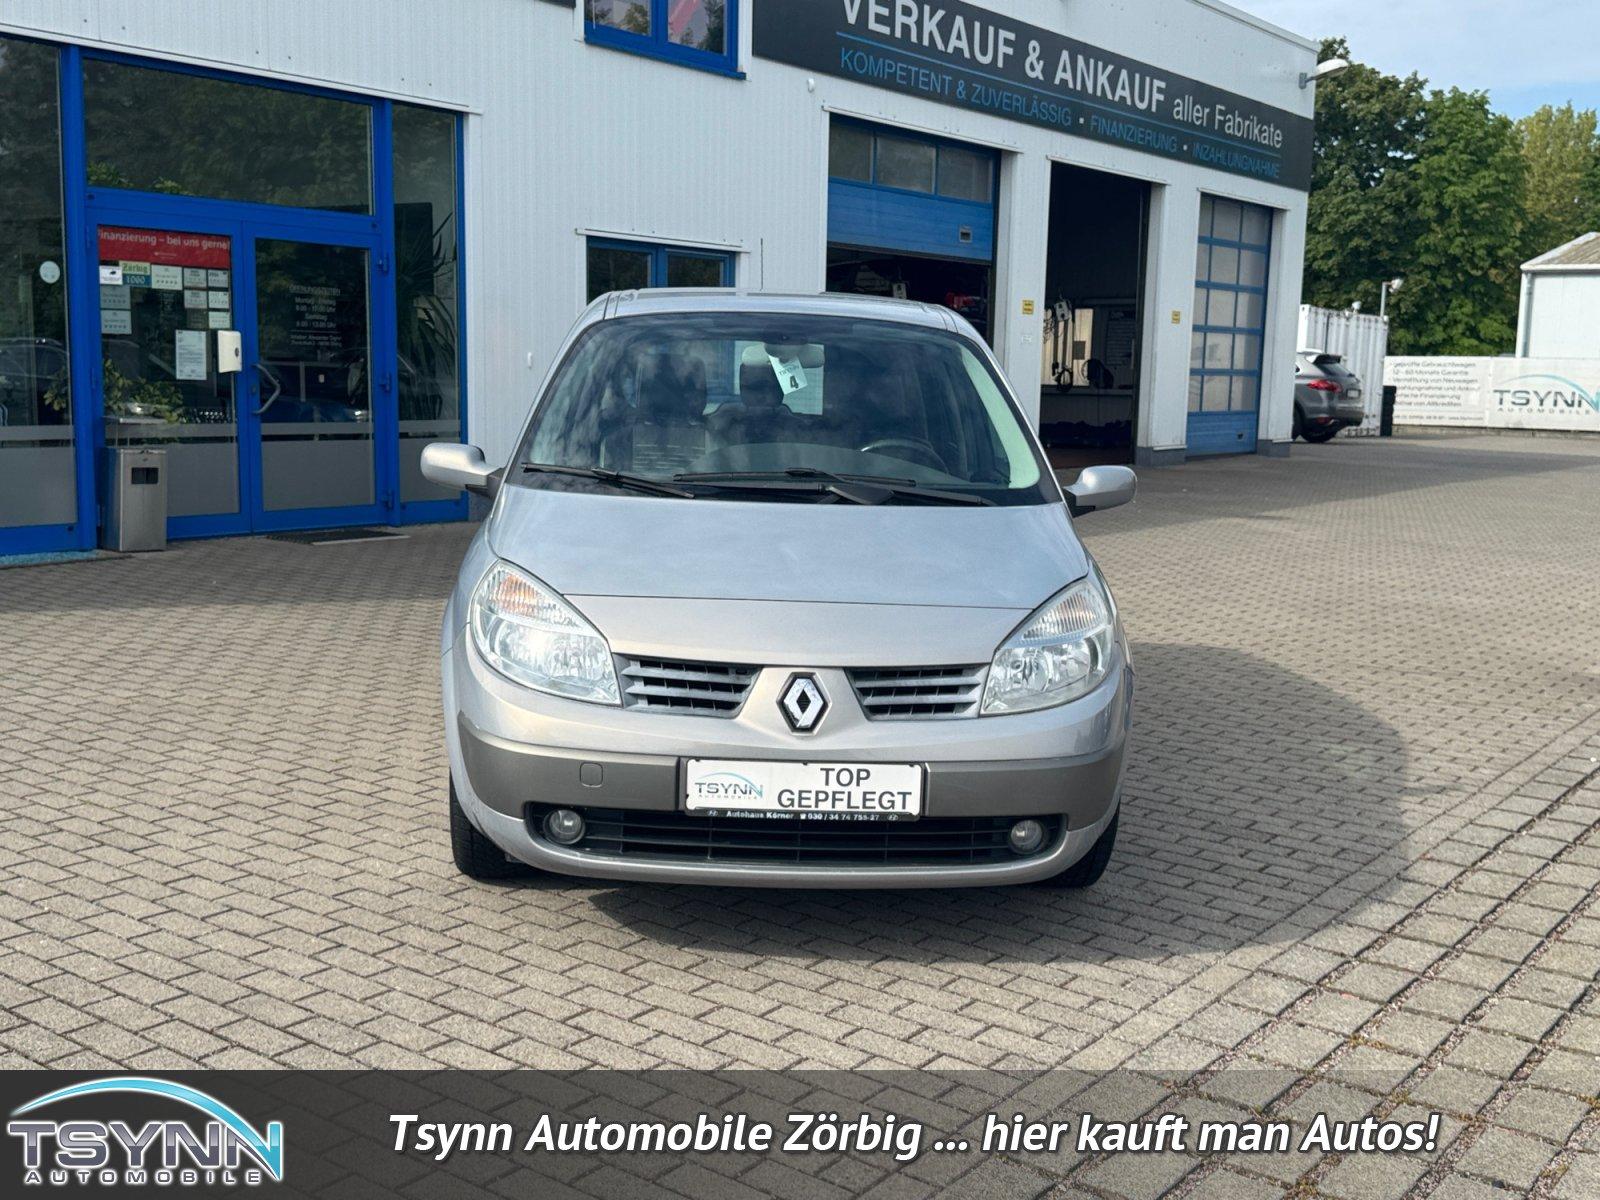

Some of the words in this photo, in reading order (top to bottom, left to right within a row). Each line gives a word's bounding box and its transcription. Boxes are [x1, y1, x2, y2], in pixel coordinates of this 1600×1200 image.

[842, 0, 1017, 68] VERKAUF
[1025, 39, 1045, 81] &
[1053, 49, 1167, 113] ANKAUF
[1173, 95, 1210, 128] aller
[1214, 104, 1284, 149] Fabrikate
[840, 47, 952, 95] KOMPETENT
[956, 79, 966, 100] &
[971, 83, 1073, 127] ZUVERLÄSSIG
[1090, 114, 1178, 153] FINANZIERUNG
[1192, 142, 1280, 179] INZAHLUNGNAHME
[167, 235, 181, 246] bei
[183, 237, 200, 247] uns
[789, 375, 799, 389] 4
[820, 768, 871, 787] TOP
[695, 783, 763, 797] TSYNN
[777, 789, 912, 810] GEPFLEGT
[726, 811, 764, 819] Autohaus
[766, 812, 794, 820] Körner
